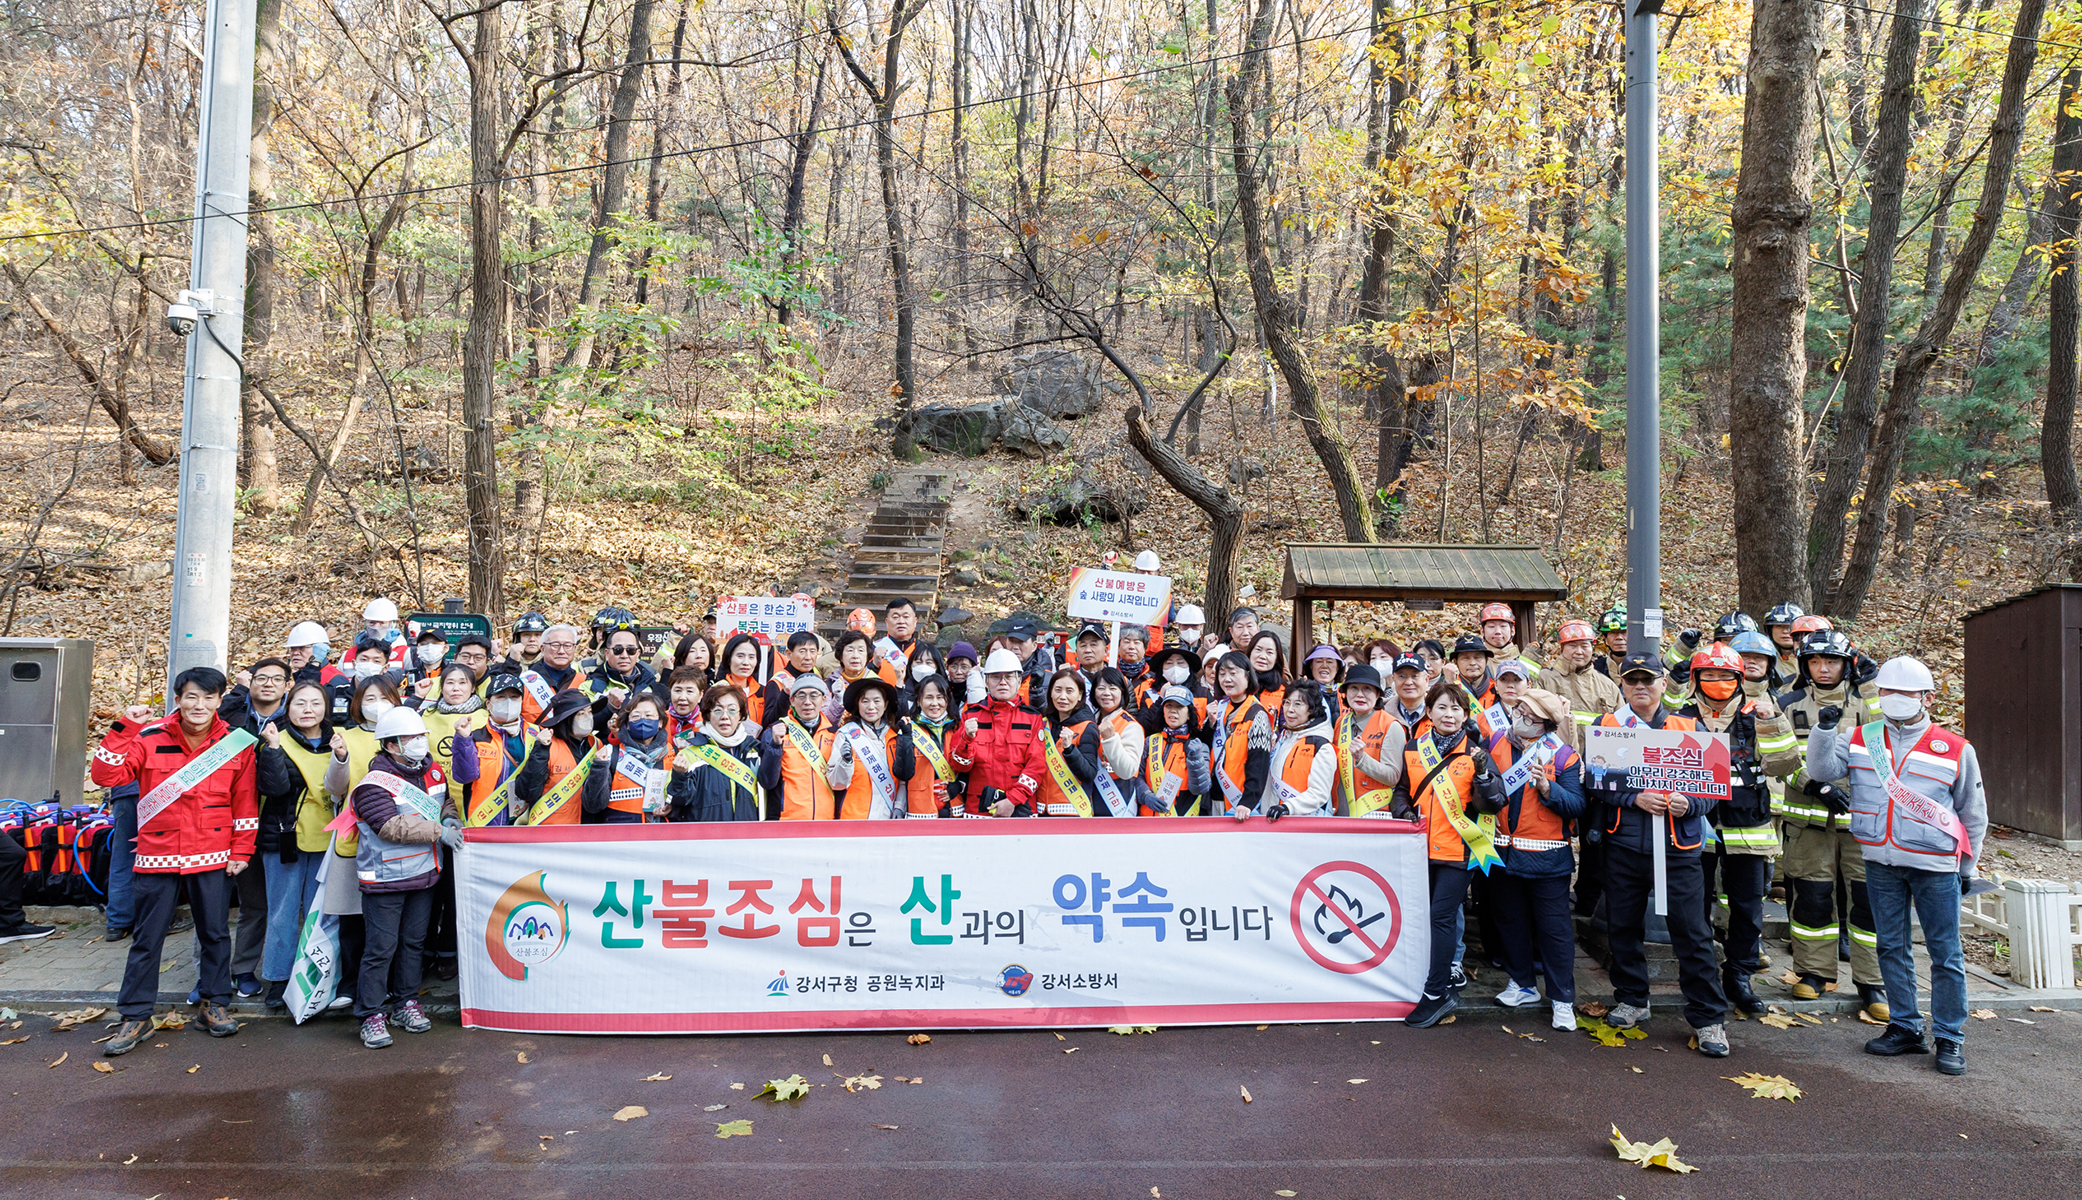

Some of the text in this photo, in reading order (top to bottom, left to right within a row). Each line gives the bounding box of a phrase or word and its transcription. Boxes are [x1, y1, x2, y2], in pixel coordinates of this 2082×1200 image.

[1094, 577, 1146, 593] 산불예방은
[726, 603, 797, 616] 산불은 한순간
[1079, 590, 1159, 608] 숲 사랑의 시작입니다
[1110, 610, 1134, 619] 강서소방서
[738, 620, 808, 634] 복구는 한평생
[788, 722, 820, 764] 함께해요
[1603, 730, 1637, 740] 강서소방서
[860, 745, 888, 783] 함께해요
[1151, 736, 1160, 772] 함께해요
[1642, 746, 1704, 768] 불조심
[720, 758, 742, 776] 흡연은
[742, 772, 755, 787] 이제
[1343, 748, 1351, 790] 산불조심
[1629, 765, 1714, 782] 아무리 강조해도
[1866, 735, 1938, 821] 함께해요 산불조심
[138, 745, 231, 820] 함께해요 산불조심
[560, 772, 583, 795] 흡연은
[1097, 773, 1121, 808] 이제 그만
[1422, 747, 1446, 786] 함께요
[1441, 787, 1471, 830] 산불조심
[1626, 777, 1727, 796] 지나치지 않습니다!
[401, 785, 441, 820] 함께해요
[544, 792, 562, 809] 이제
[1063, 778, 1078, 795] 이제
[1075, 794, 1088, 812] 그만
[592, 871, 1273, 949] 산불조심은 산과의 약속입니다
[515, 947, 549, 957] 산불조심
[796, 974, 945, 993] 강서구청 공원녹지과
[1041, 972, 1119, 990] 강서소방서
